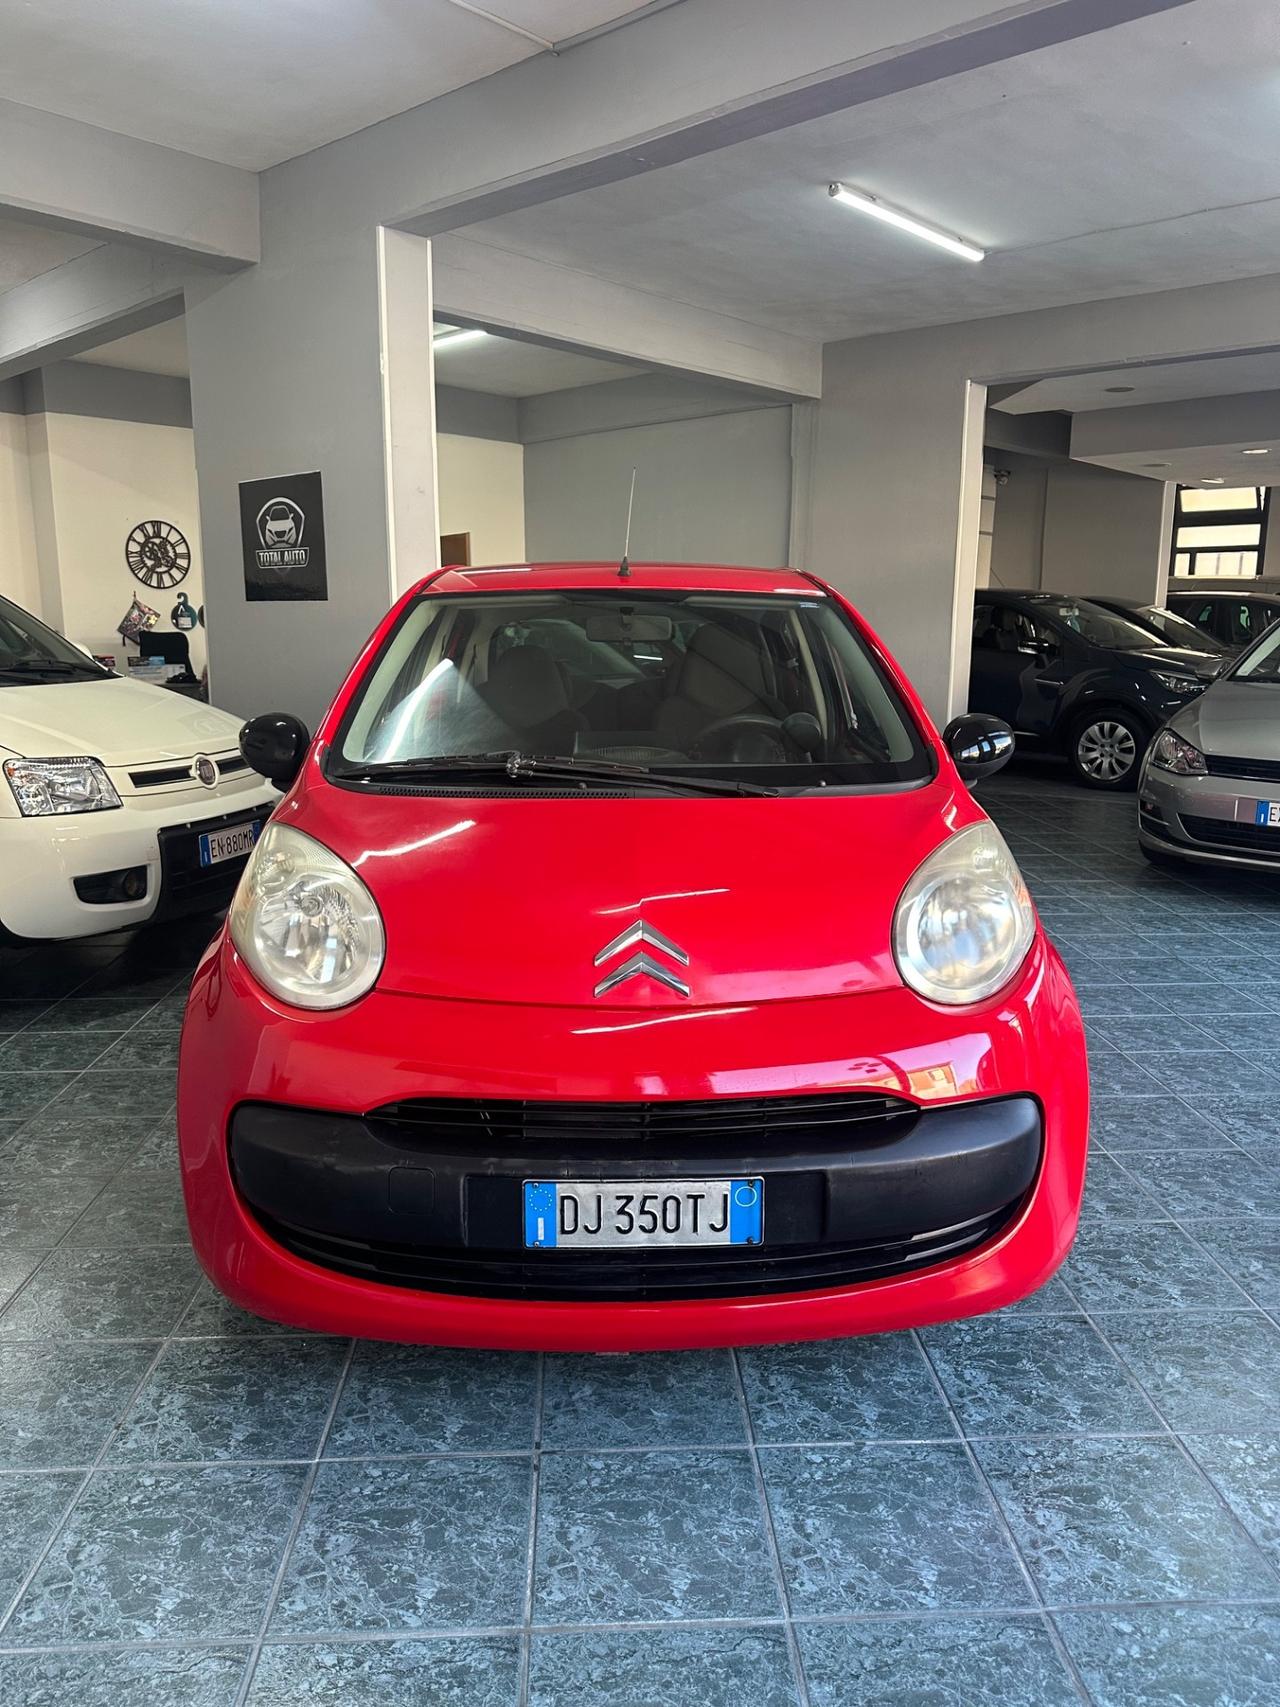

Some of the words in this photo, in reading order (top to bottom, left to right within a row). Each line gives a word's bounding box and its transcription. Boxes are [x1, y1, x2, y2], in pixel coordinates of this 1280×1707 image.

[259, 551, 282, 566] TOTAL
[284, 549, 306, 565] AUTO
[1269, 806, 1280, 822] E
